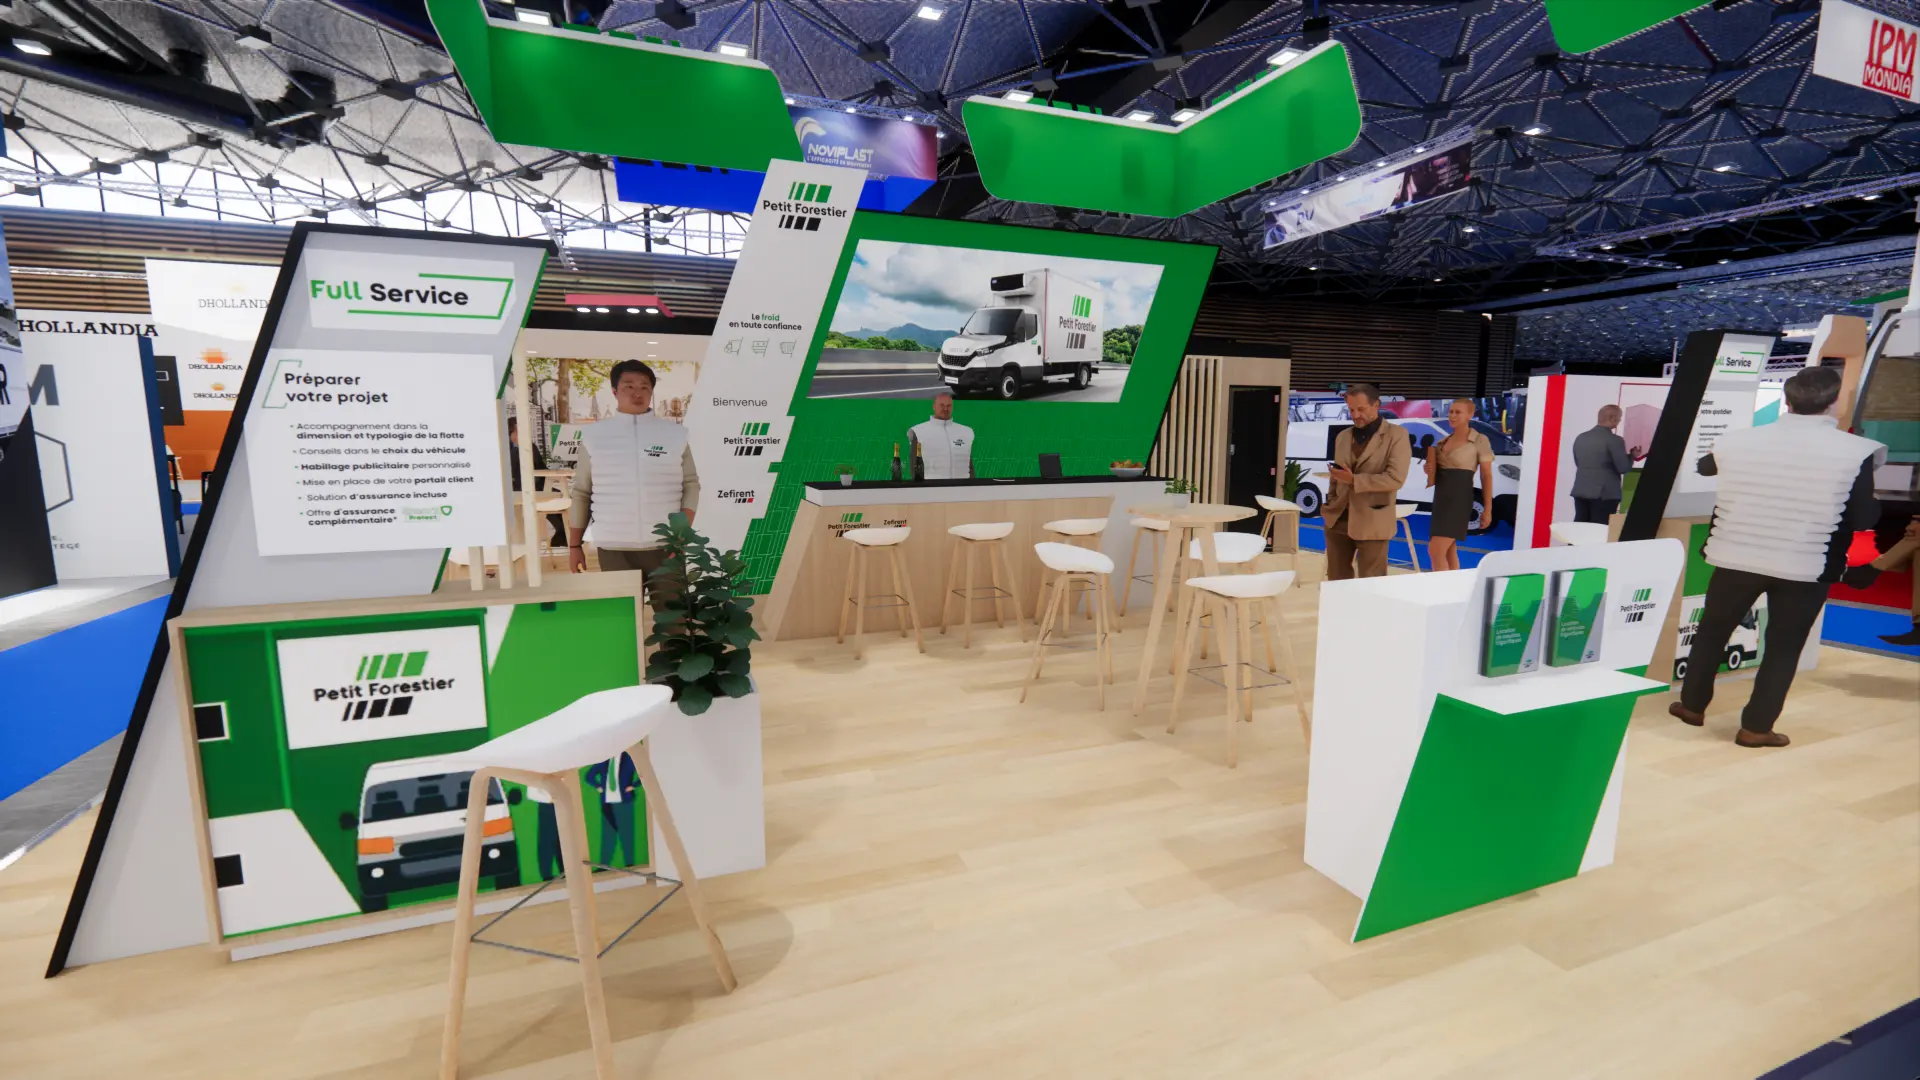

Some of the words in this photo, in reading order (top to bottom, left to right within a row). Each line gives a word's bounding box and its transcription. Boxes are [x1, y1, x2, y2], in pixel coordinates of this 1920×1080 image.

[1867, 19, 1917, 75] IPM
[1863, 64, 1911, 95] MONDIA
[807, 143, 874, 163] NOVIPLAST
[763, 200, 792, 212] Petit
[795, 203, 847, 218] Forestier
[310, 279, 363, 300] Full
[369, 282, 469, 306] Service
[751, 313, 760, 321] Le
[761, 313, 780, 321] froid
[740, 321, 762, 329] toute
[763, 322, 802, 331] confiance
[1059, 315, 1074, 329] Petit
[1074, 318, 1097, 332] Forestier
[1726, 356, 1752, 367] Service
[284, 372, 361, 388] Préparer
[286, 391, 333, 402] votre
[337, 391, 389, 406] projet
[712, 397, 768, 407] Bienvenue
[297, 423, 391, 432] Accompagnement
[297, 432, 352, 440] dimension
[366, 432, 413, 441] typologie
[414, 432, 427, 440] de
[428, 432, 438, 440] la
[439, 432, 465, 440] flotte
[723, 437, 743, 445] Petit
[745, 437, 781, 445] Forestier
[299, 447, 342, 455] Conseils
[344, 447, 369, 455] dans
[371, 447, 380, 455] le
[425, 446, 466, 454] véhicule
[301, 463, 351, 472] Habillage
[352, 462, 410, 471] publicitaire
[411, 461, 471, 470] personnalisé
[302, 478, 325, 486] Mise
[343, 478, 371, 487] place
[414, 475, 446, 485] portail
[448, 475, 475, 483] client
[307, 493, 347, 502] Solution
[413, 491, 448, 499] incluse
[717, 489, 755, 499] Zefirent
[306, 508, 331, 517] Offre
[1620, 603, 1633, 612] Petit
[1633, 602, 1656, 611] Forestier
[313, 684, 363, 702] Petit
[368, 677, 456, 697] Forestier
